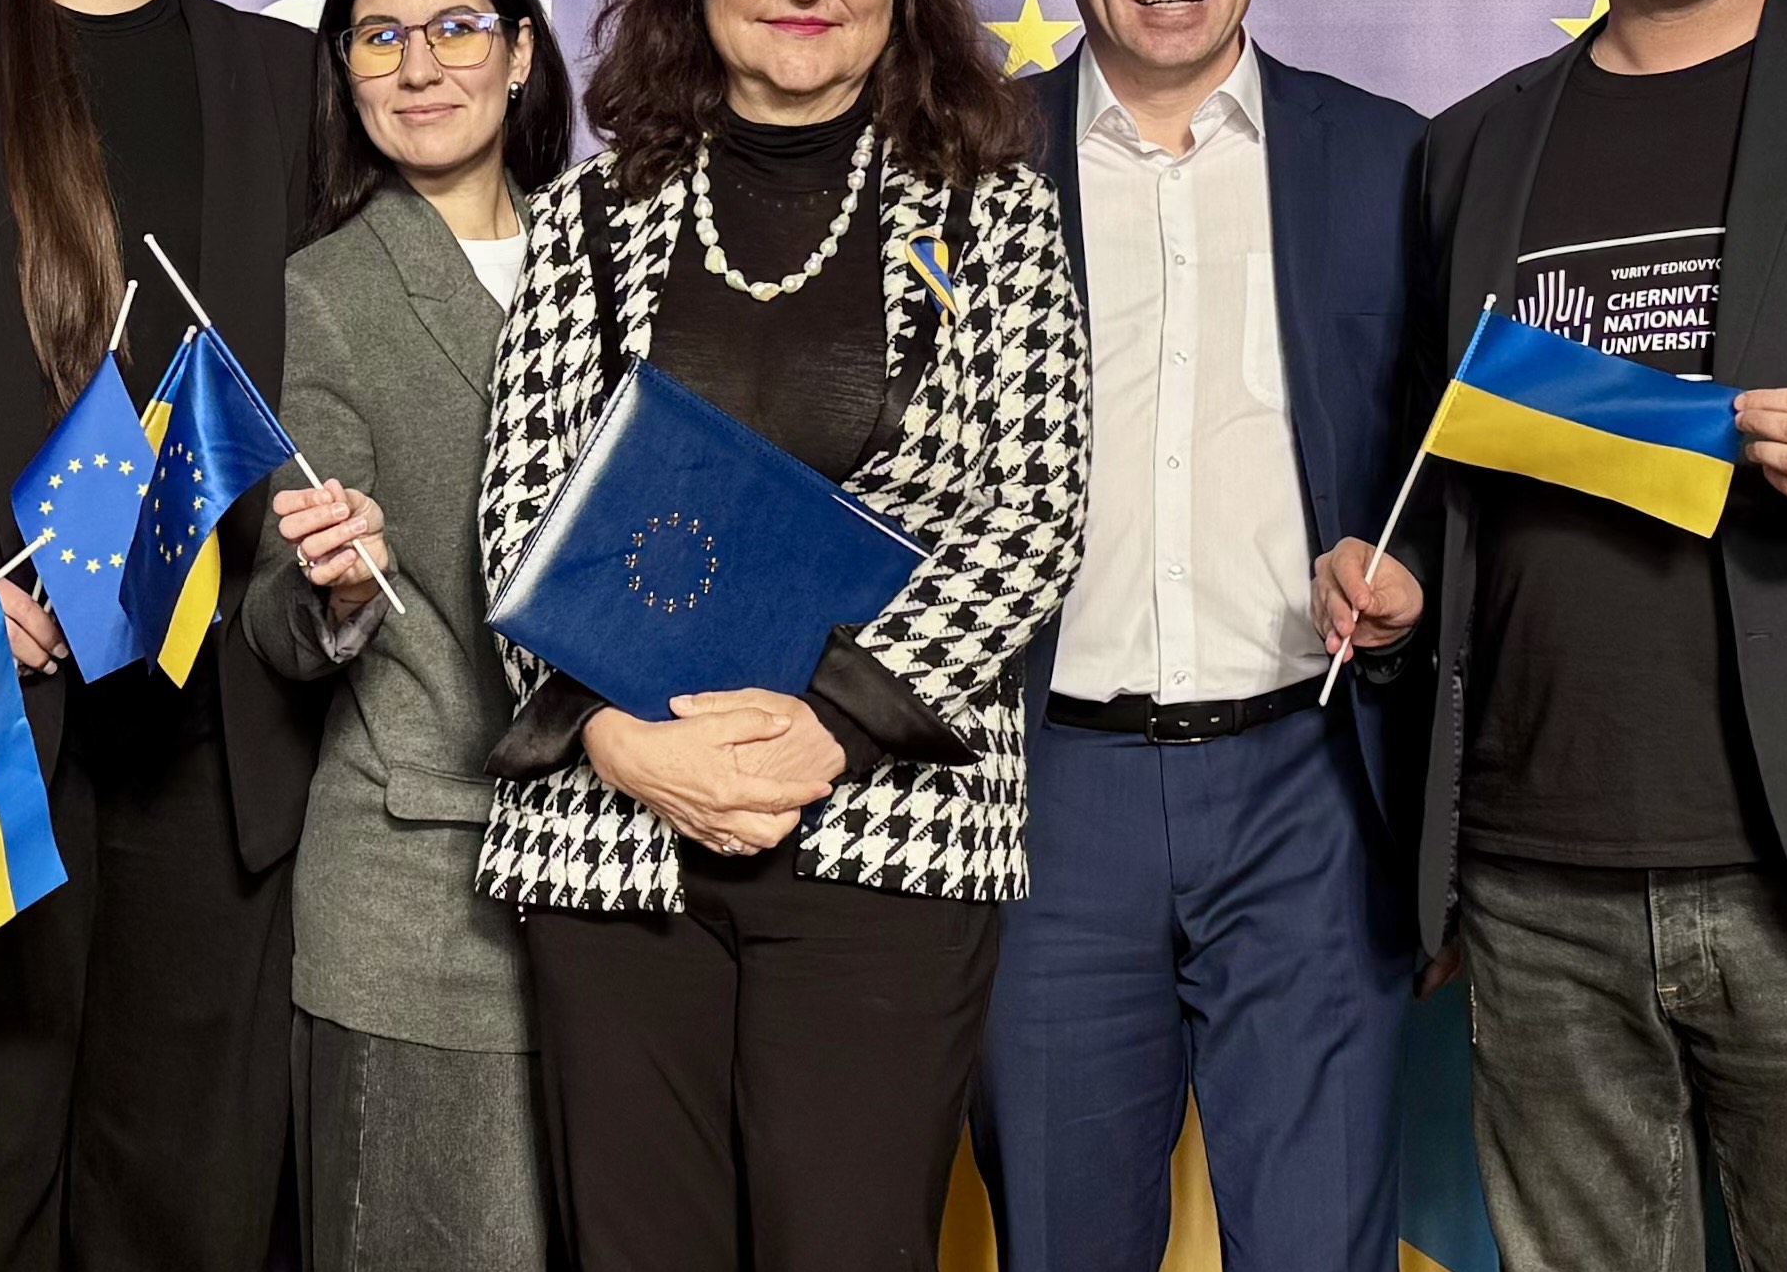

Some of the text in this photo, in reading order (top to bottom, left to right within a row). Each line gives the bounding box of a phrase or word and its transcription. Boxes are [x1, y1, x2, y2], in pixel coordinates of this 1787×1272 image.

[1611, 258, 1722, 281] YURIY FEDKOVYC
[1607, 284, 1719, 311] CHERNIVTS
[1603, 307, 1710, 334] NATIONAL
[1601, 331, 1716, 355] UNIVERSIT
